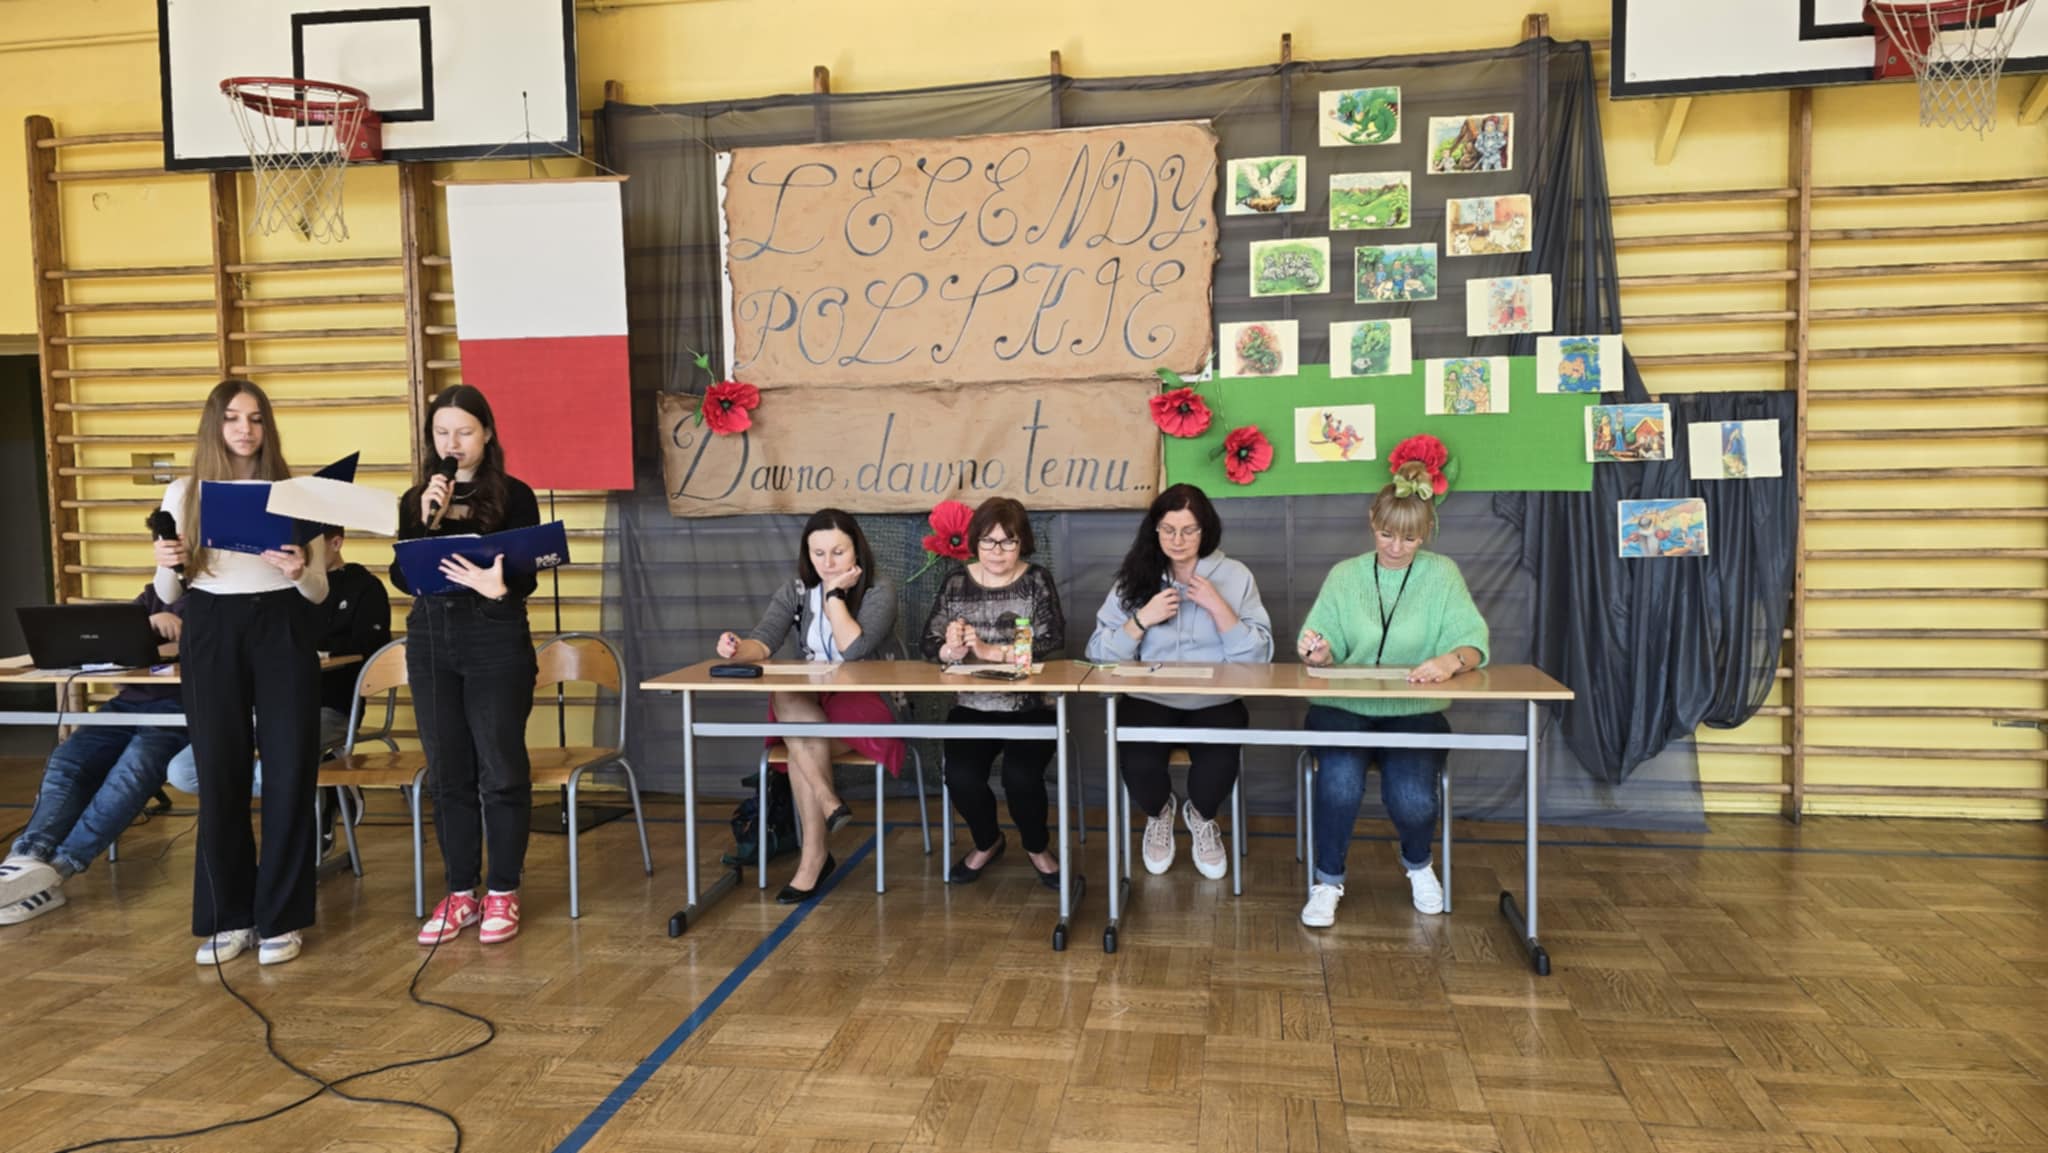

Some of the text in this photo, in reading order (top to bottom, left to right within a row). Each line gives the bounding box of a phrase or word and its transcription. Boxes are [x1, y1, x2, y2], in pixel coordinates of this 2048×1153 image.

[730, 141, 1217, 260] LEGENDY
[733, 257, 1185, 368] POLSKIE
[856, 412, 1003, 493] dawno
[1022, 399, 1152, 494] temu...
